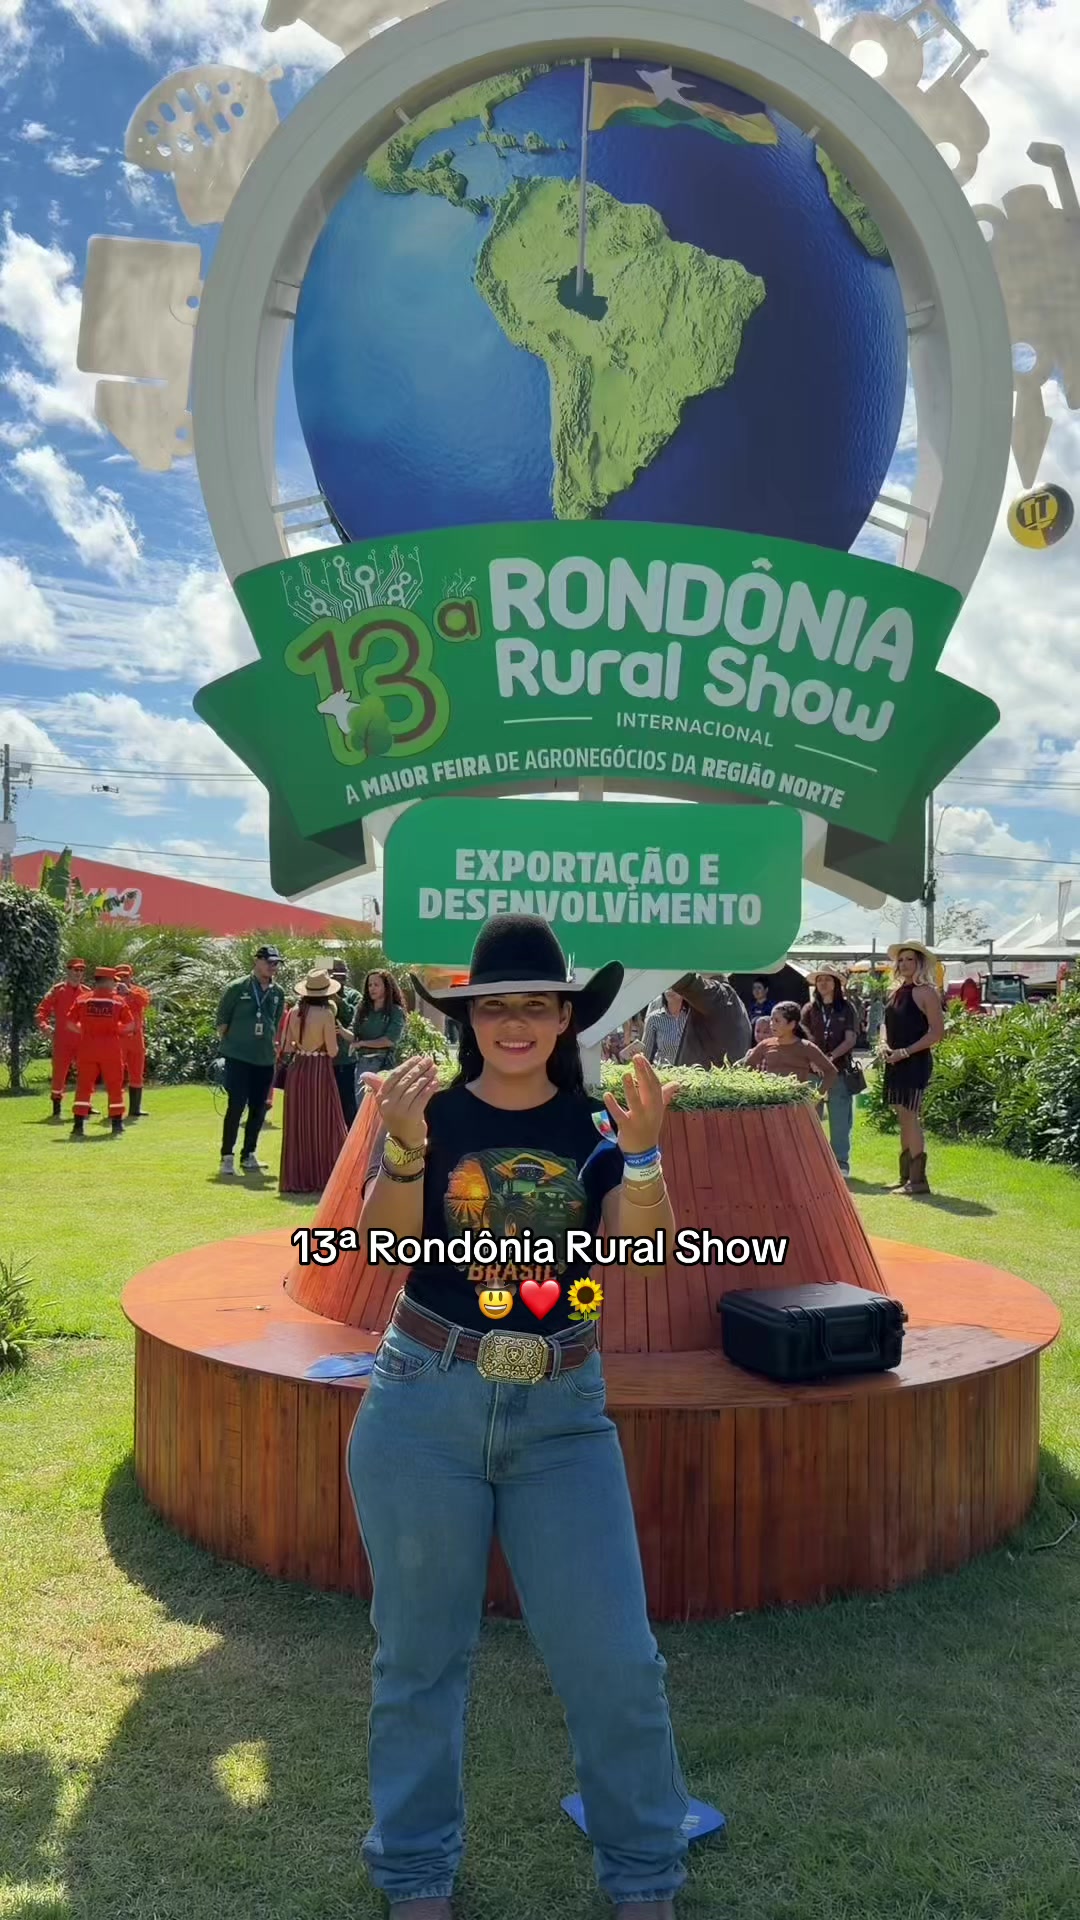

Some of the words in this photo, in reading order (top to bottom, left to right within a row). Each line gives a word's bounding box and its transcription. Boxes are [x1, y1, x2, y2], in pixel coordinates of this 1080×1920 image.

[489, 555, 915, 684] RONDÔNIA
[494, 636, 683, 701] Rural
[703, 645, 896, 743] Show
[616, 711, 775, 748] INTERNACIONAL
[345, 784, 361, 806] A
[360, 764, 430, 801] MAIOR
[431, 754, 492, 783] FEIRA
[495, 751, 521, 773] DE
[524, 745, 667, 771] AGRONEGÓCIOS
[670, 753, 697, 776] DA
[701, 757, 777, 791] REGIÃO
[777, 772, 846, 810] NORTE
[455, 846, 690, 890] EXPORTAÇÃO
[699, 853, 720, 886] E
